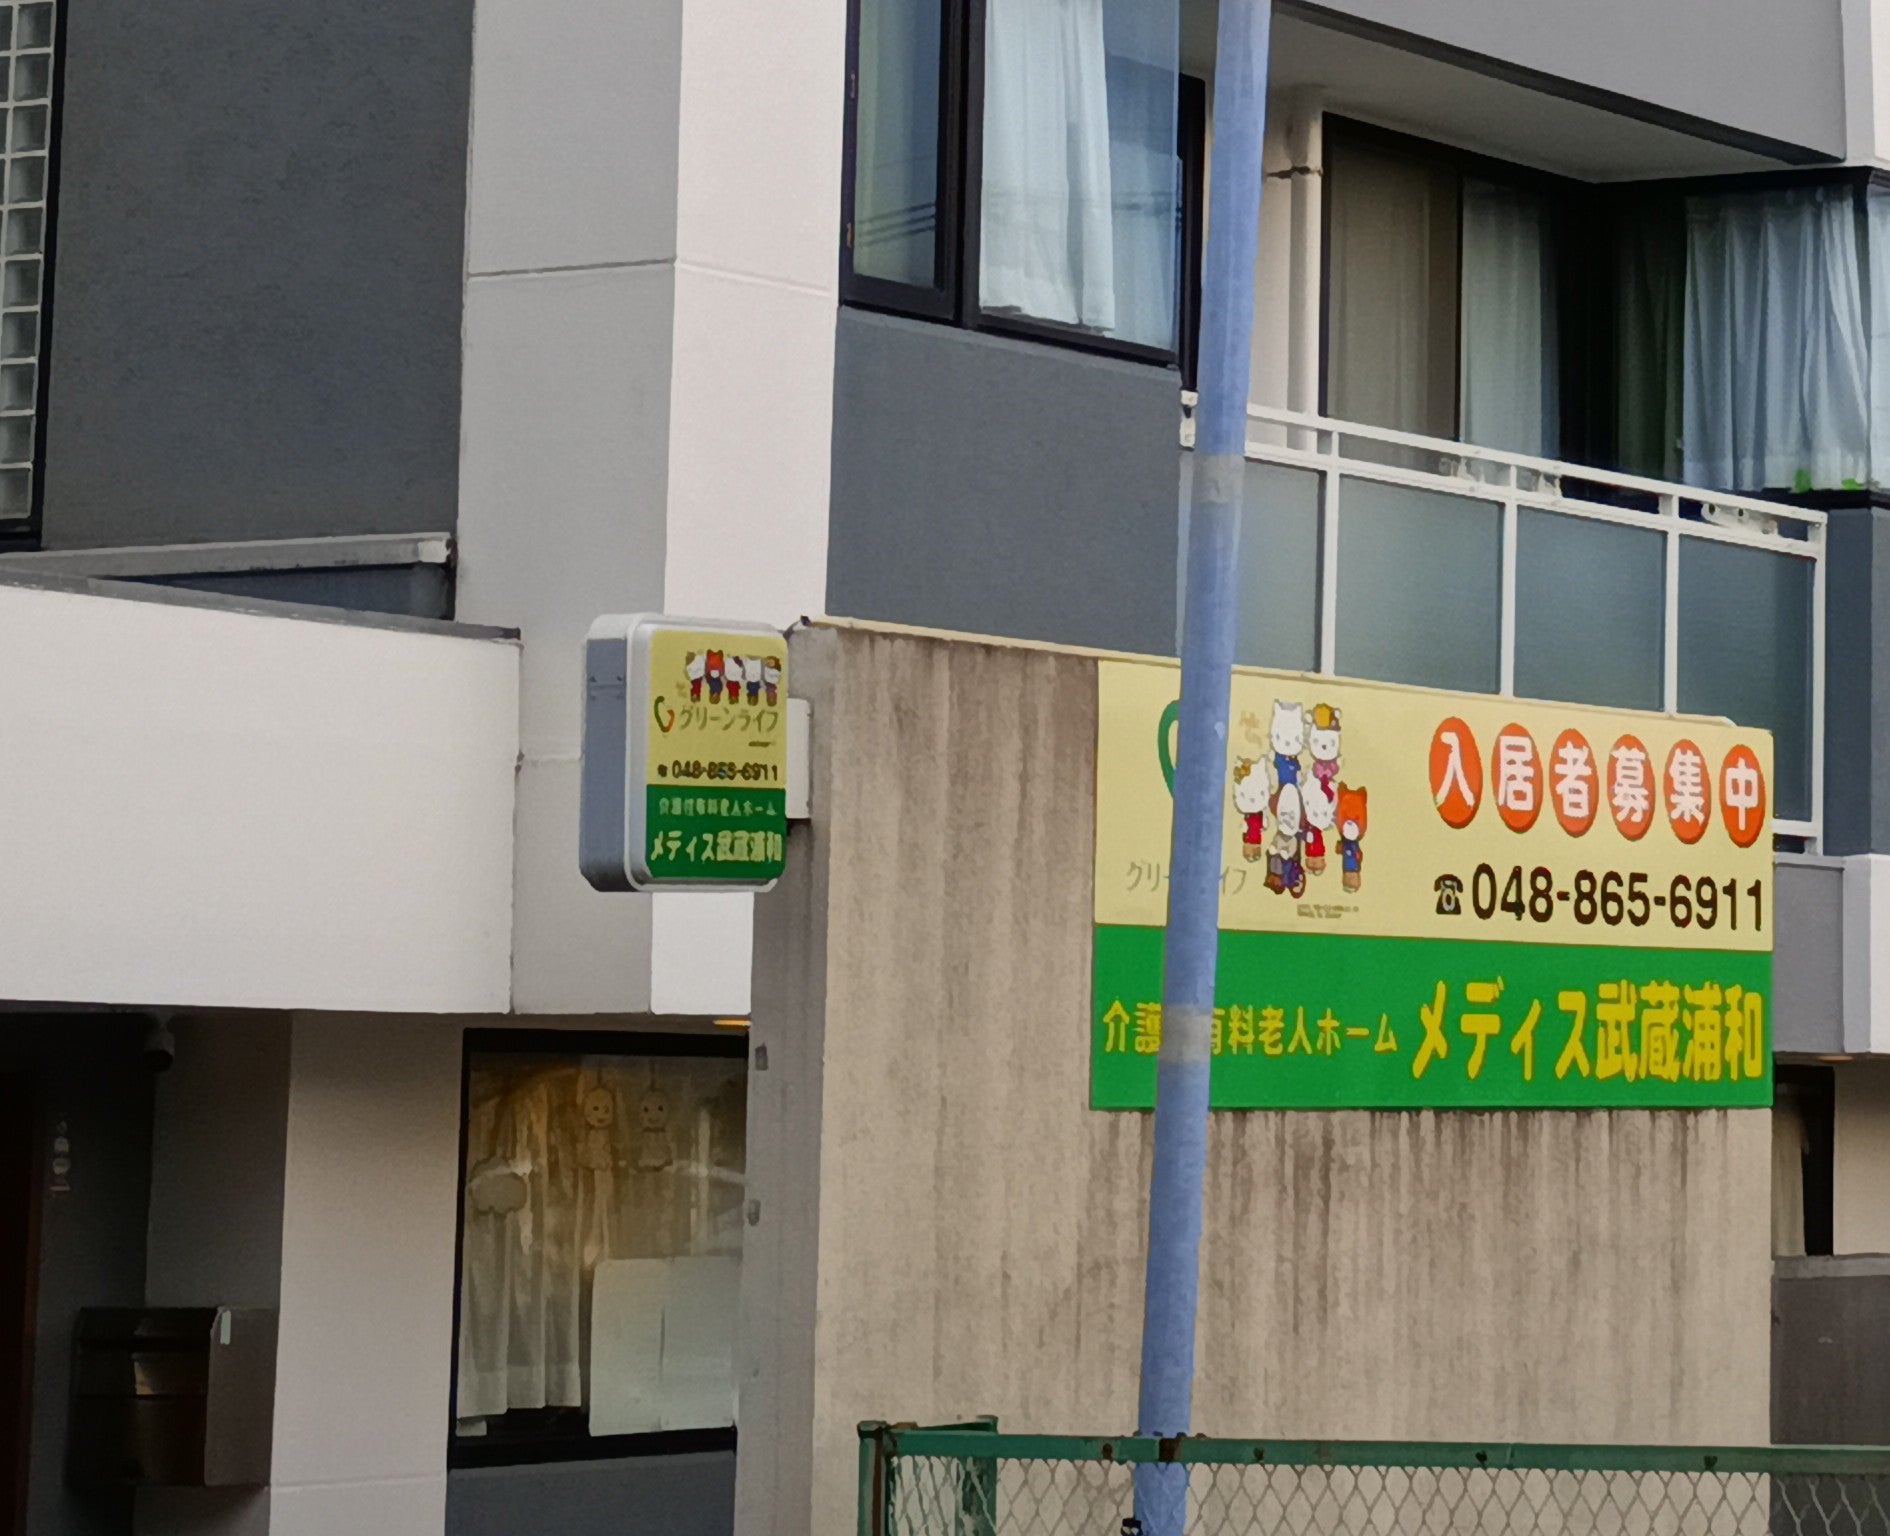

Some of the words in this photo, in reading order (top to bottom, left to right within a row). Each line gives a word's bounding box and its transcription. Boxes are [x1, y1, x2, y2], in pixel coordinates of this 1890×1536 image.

[680, 705, 778, 732] グリーンライフ
[1433, 731, 1759, 831] 入居者募集中
[1472, 863, 1762, 931] 048-865-6911
[1103, 1000, 1397, 1056] 介護有料老人ホーム
[1412, 975, 1763, 1083] メディス武蔵浦和
